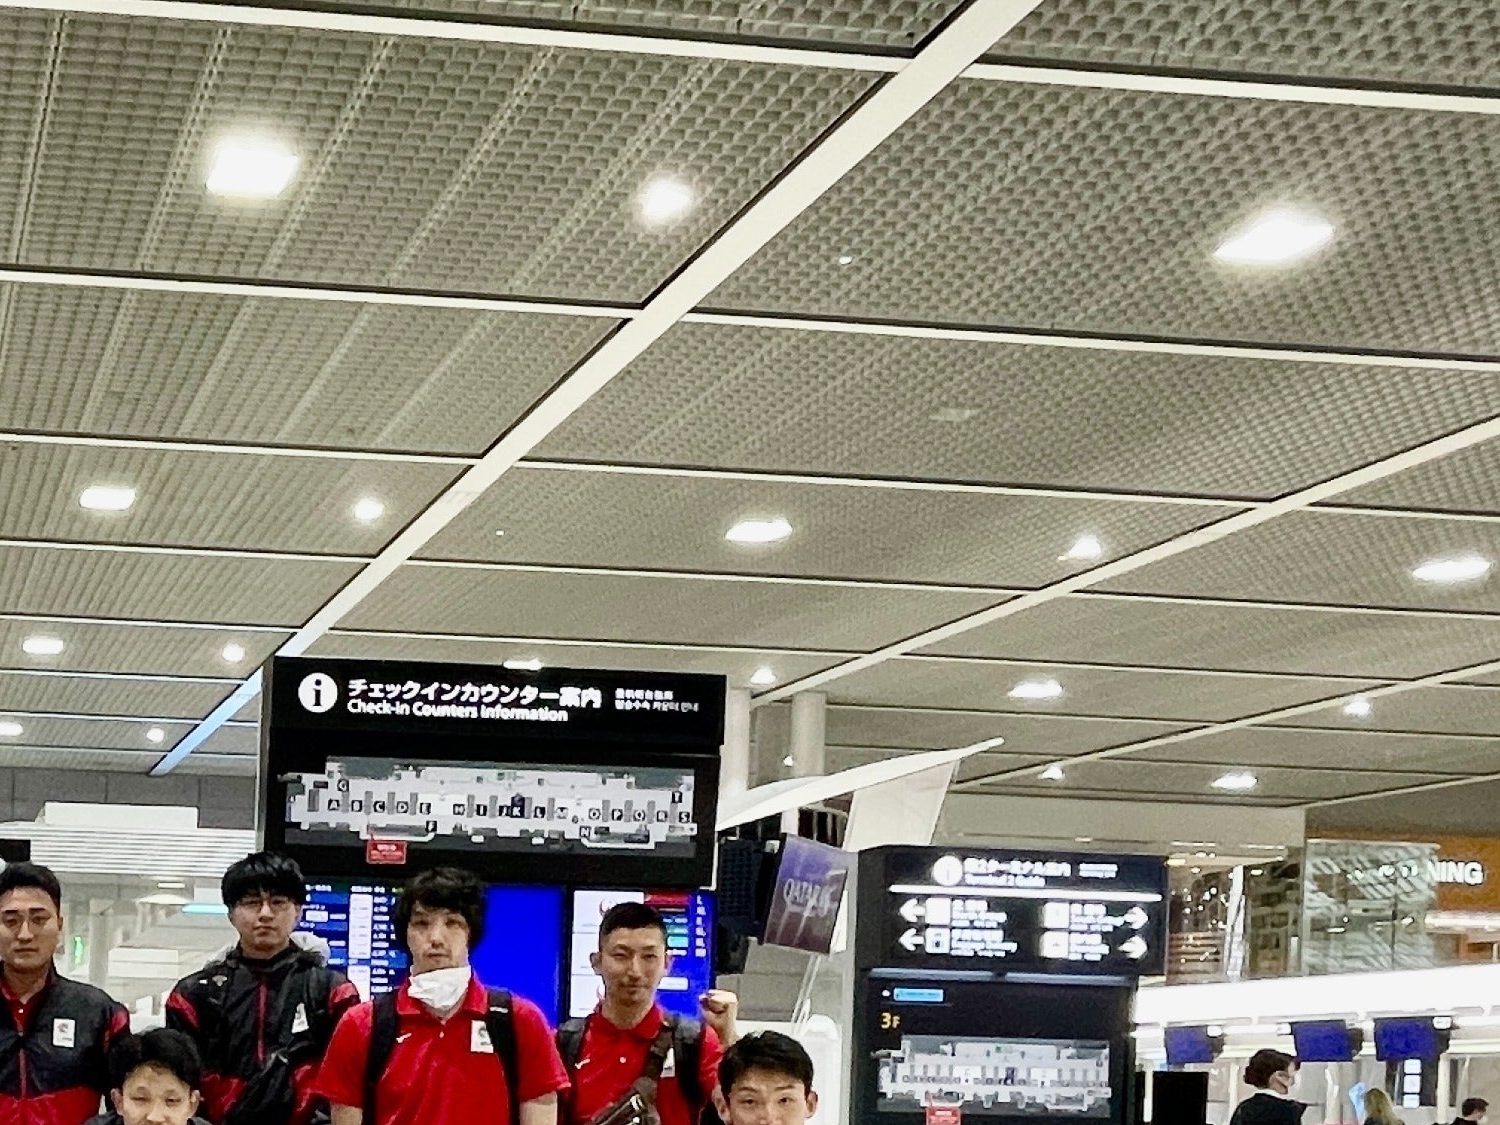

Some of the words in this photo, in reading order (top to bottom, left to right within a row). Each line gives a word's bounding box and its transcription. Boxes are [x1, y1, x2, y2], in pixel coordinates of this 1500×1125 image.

[348, 678, 600, 709] チェックインカウンター案内
[412, 702, 478, 720] Counters
[480, 705, 569, 723] Information
[880, 1011, 901, 1030] 3F
